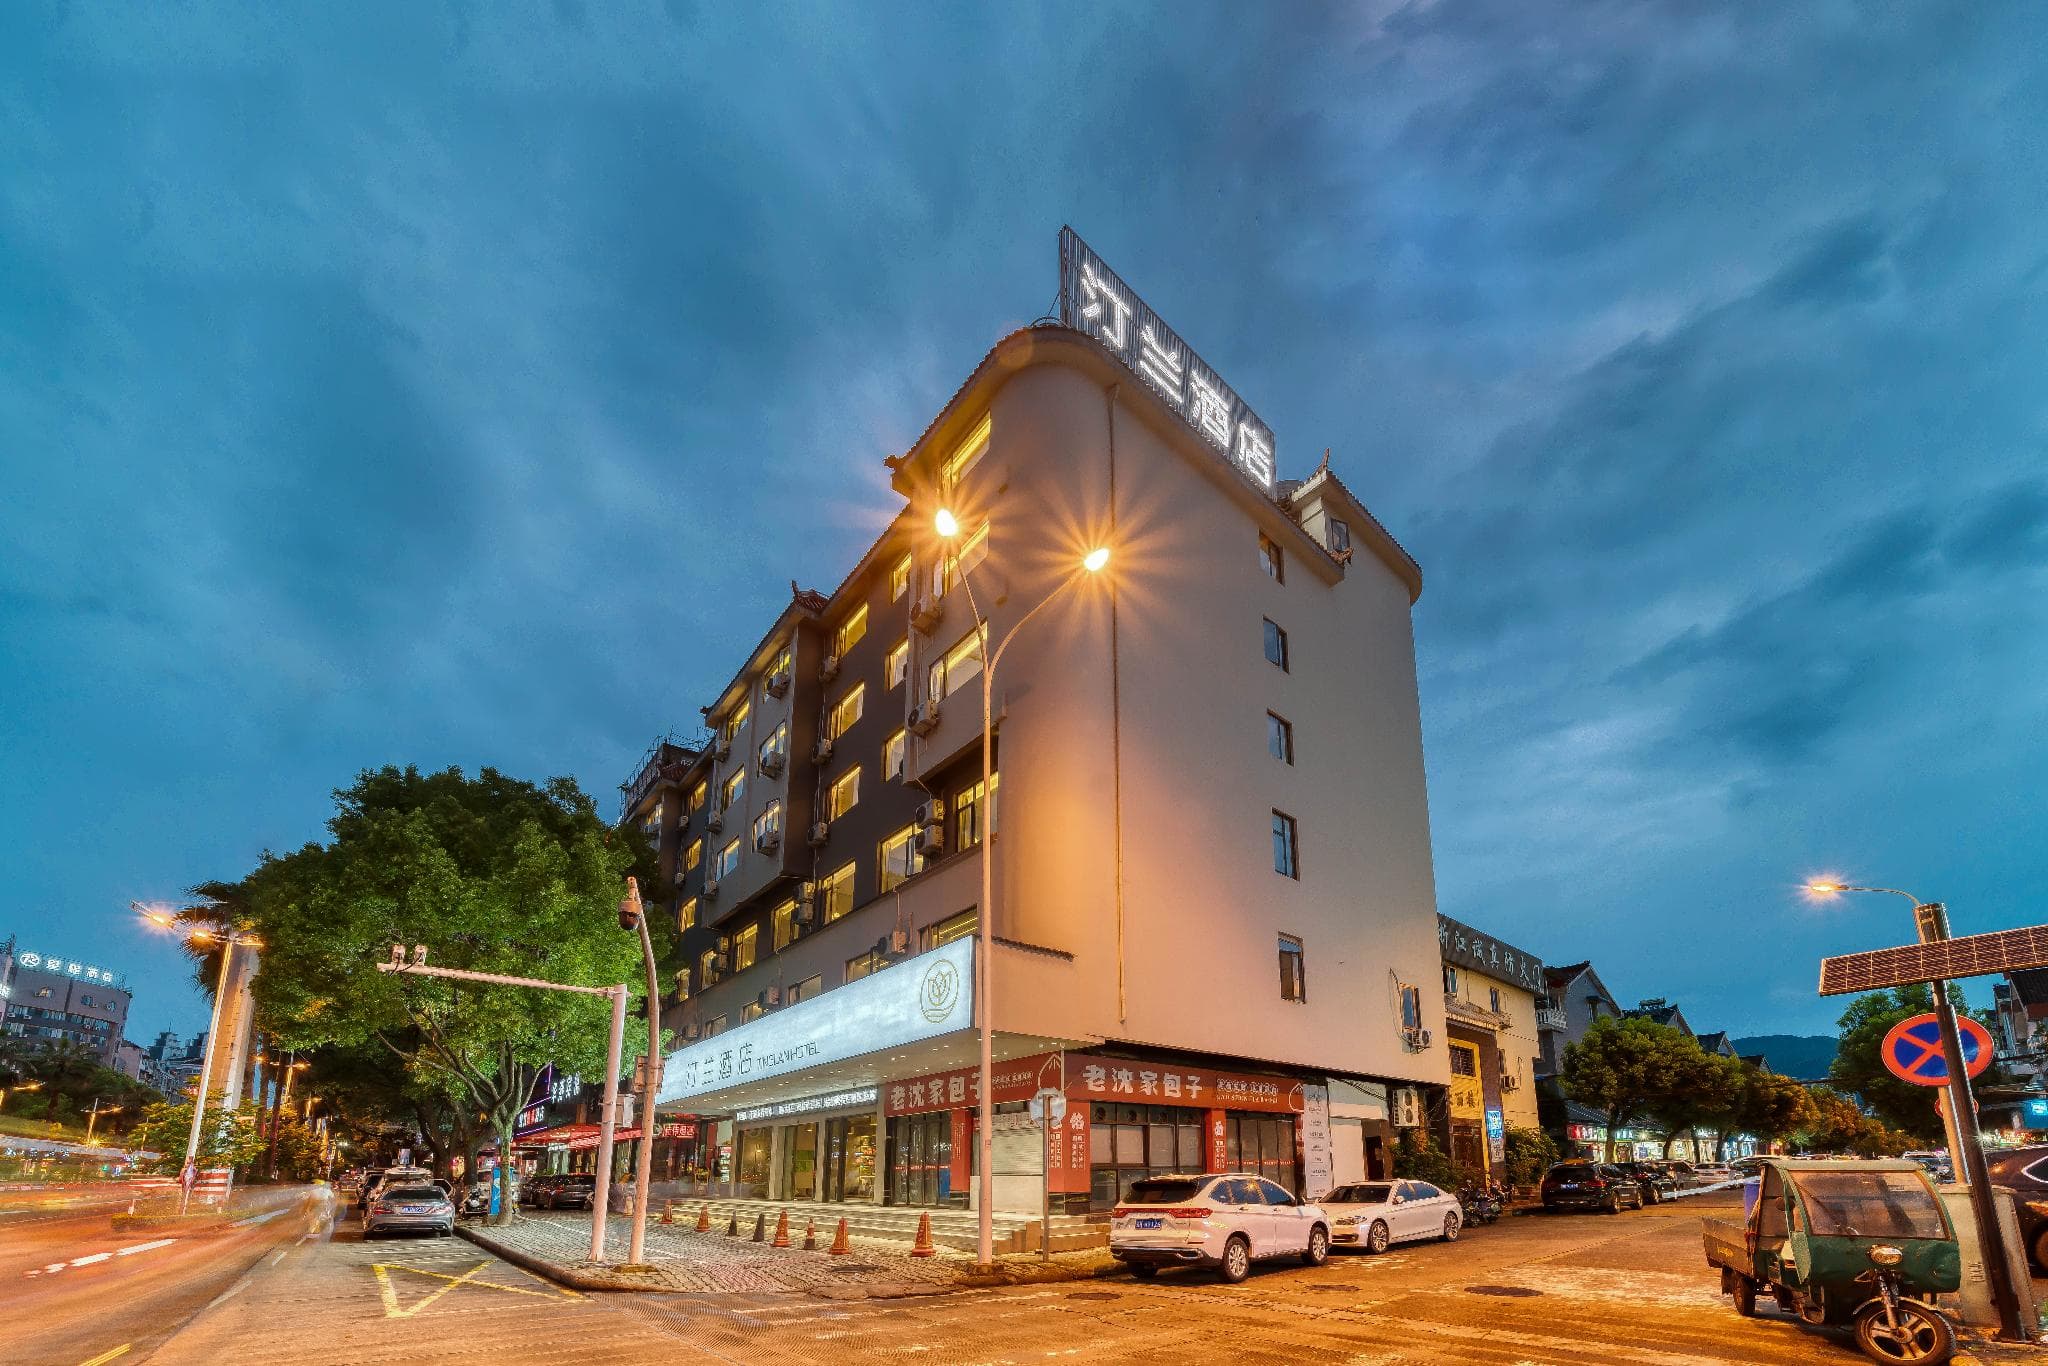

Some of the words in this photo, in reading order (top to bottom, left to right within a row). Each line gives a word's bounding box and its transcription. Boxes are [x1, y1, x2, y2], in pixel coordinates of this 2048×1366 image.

[1081, 263, 1271, 488] 汀兰酒店
[686, 1042, 753, 1088] 汀兰酒店
[1082, 1064, 1203, 1099] 老沈家包子
